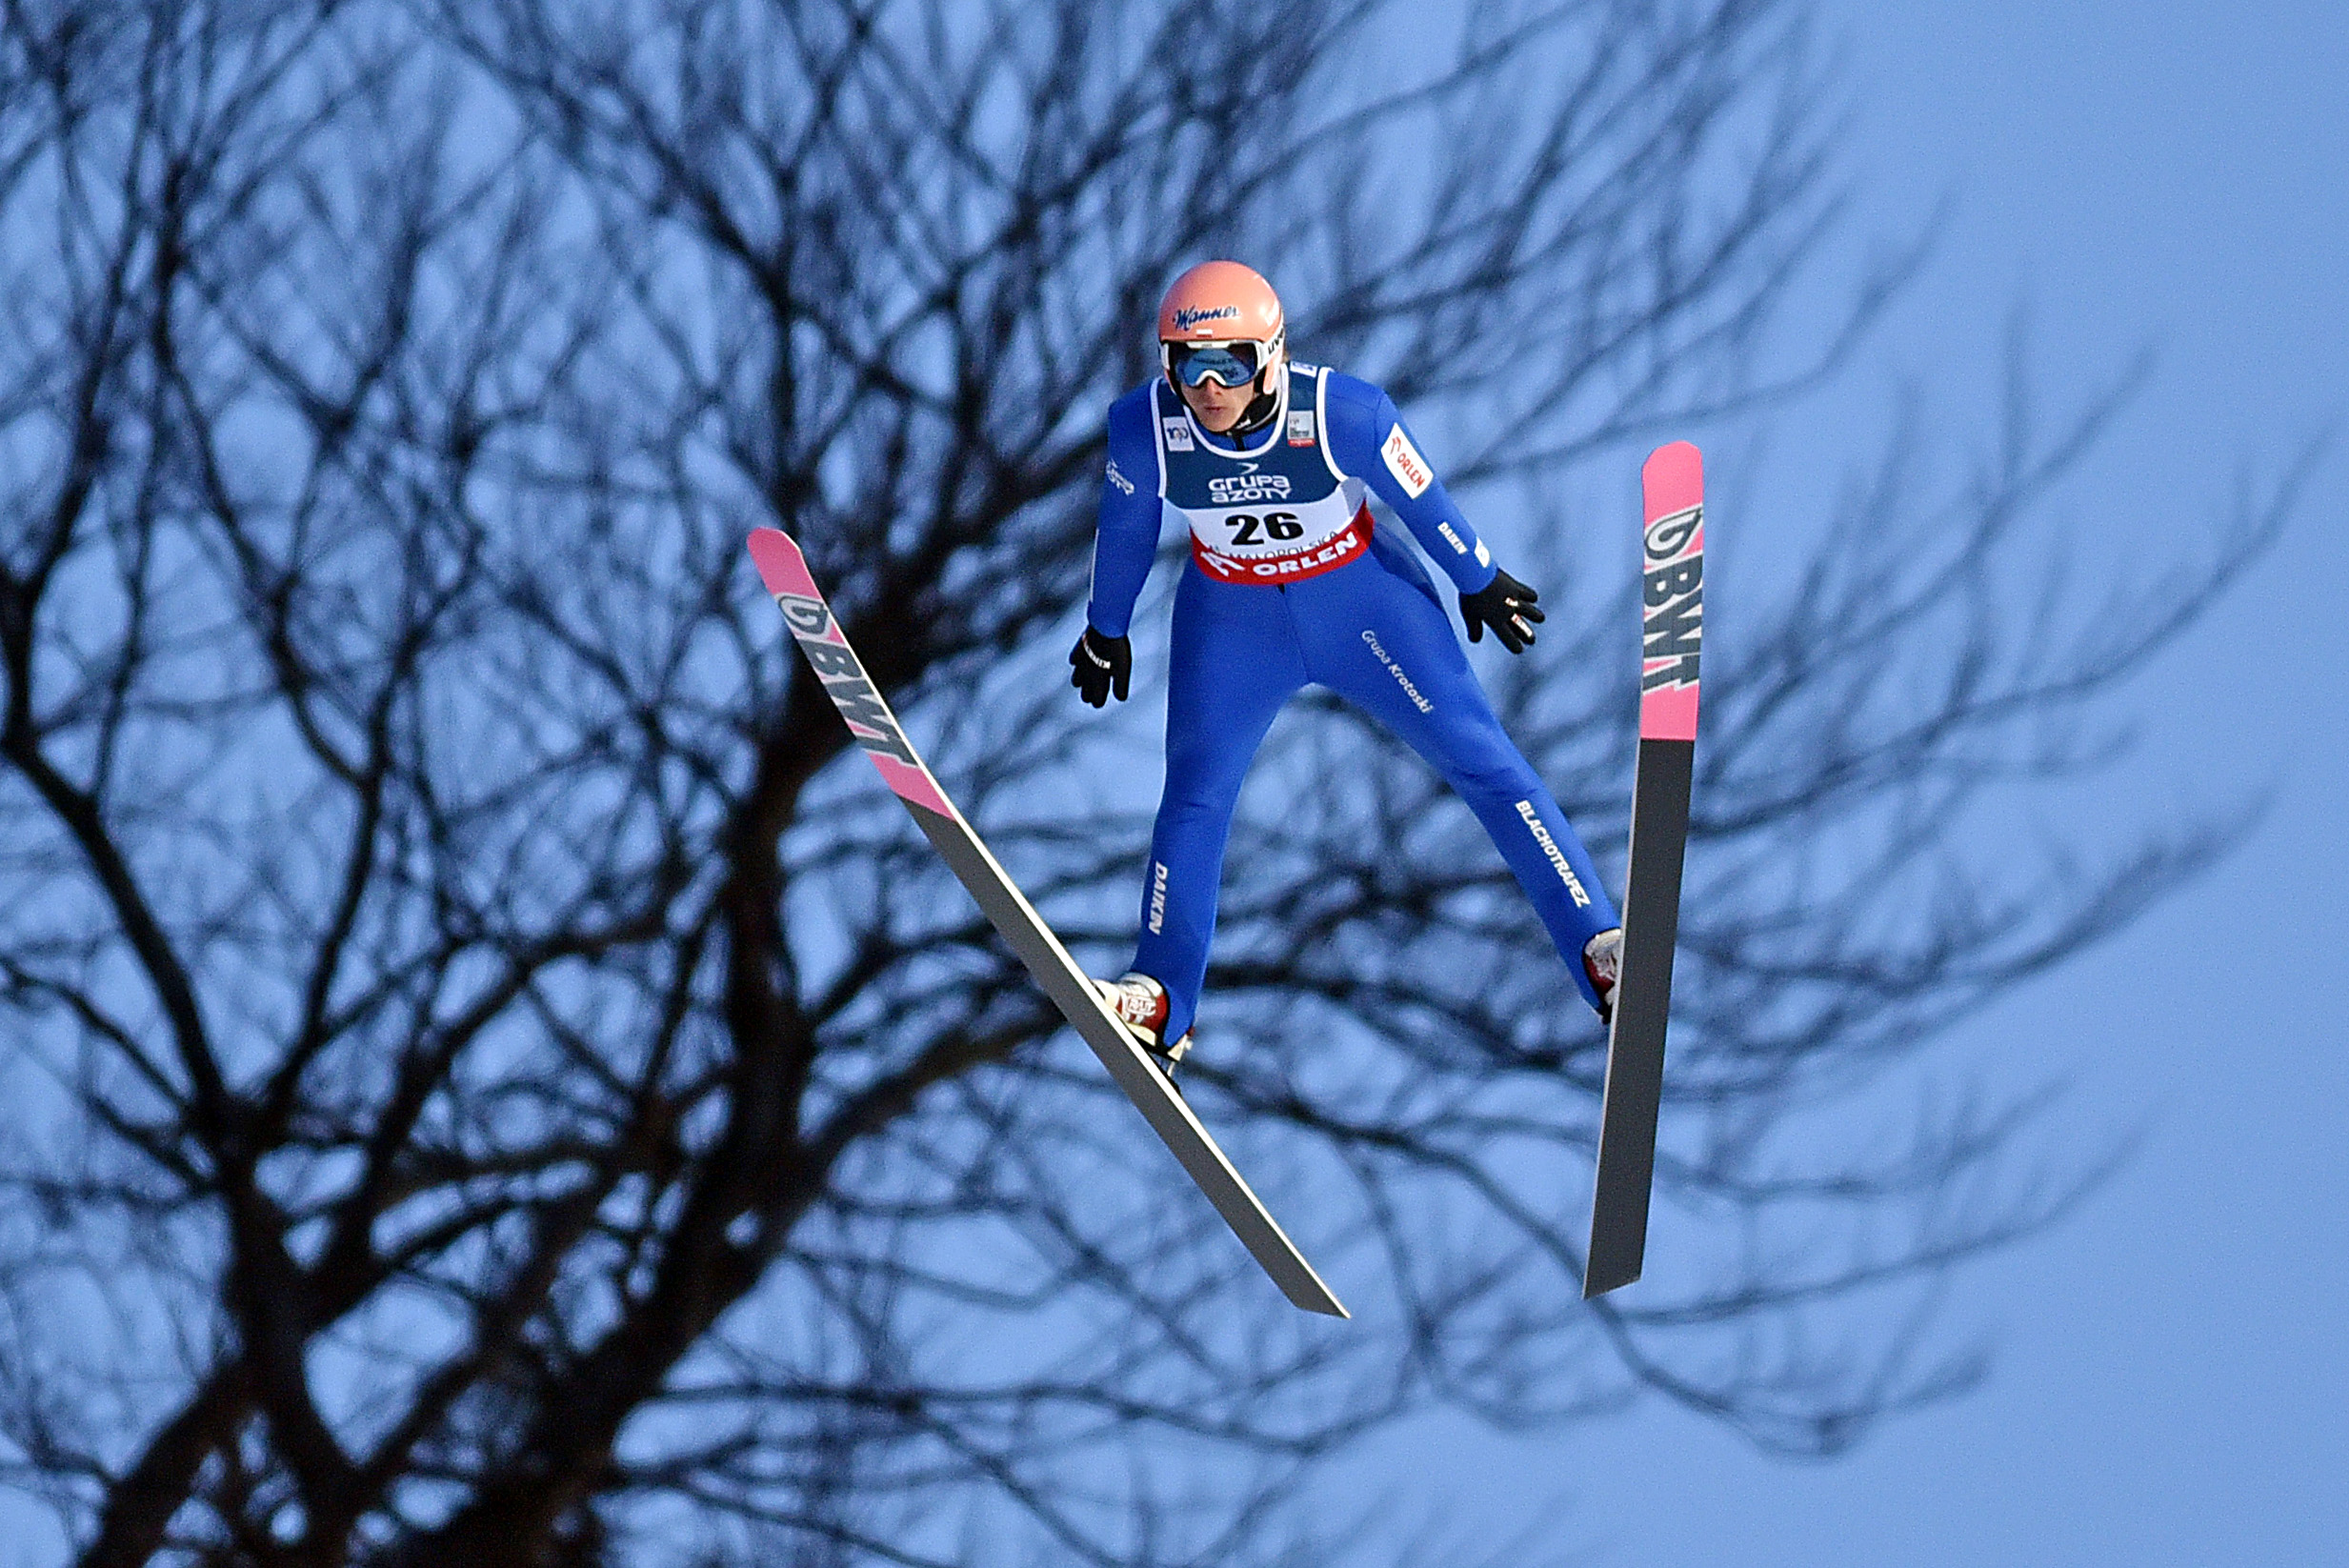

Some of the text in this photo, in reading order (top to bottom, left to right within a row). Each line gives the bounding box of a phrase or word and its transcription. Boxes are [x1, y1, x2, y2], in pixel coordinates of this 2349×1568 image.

[1173, 304, 1236, 332] Manner
[1396, 452, 1426, 489] ORLEN
[1225, 512, 1304, 546] 26
[1253, 531, 1359, 576] ORLEN
[1642, 553, 1703, 694] BWT
[796, 637, 919, 768] BWT
[1361, 630, 1434, 713] Grupa Krotoski
[1515, 799, 1591, 908] BLACHOTRAPEZ
[1149, 860, 1168, 935] DAIKIN
